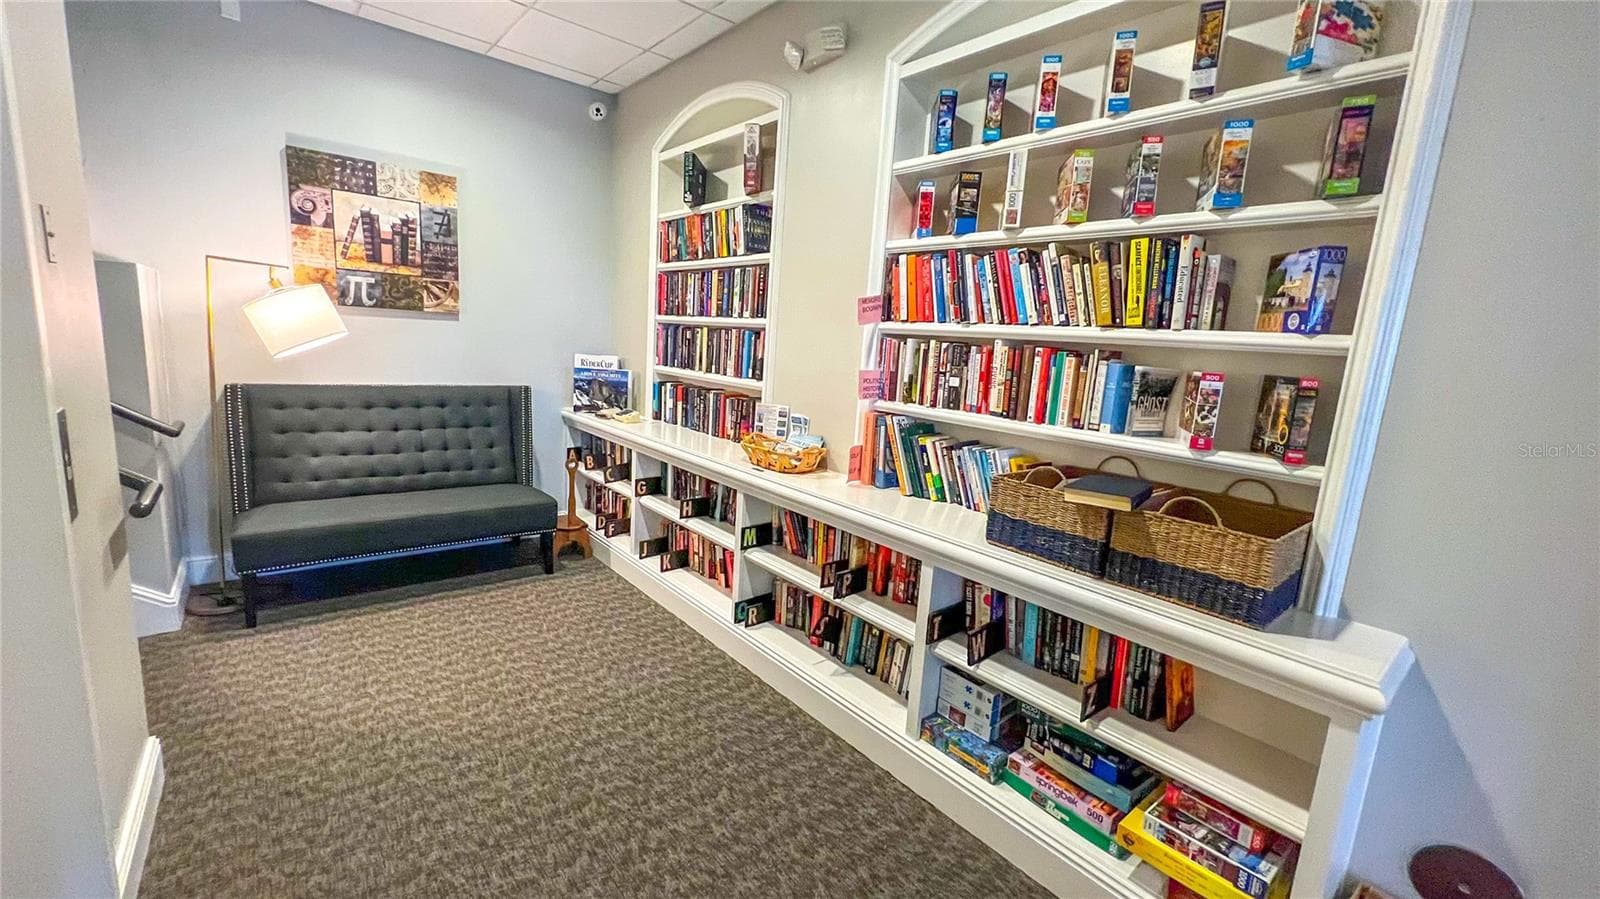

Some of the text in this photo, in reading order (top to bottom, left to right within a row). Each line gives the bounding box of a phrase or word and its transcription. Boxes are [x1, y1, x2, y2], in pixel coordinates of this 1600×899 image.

[1099, 264, 1109, 314] ELEANOR
[1177, 265, 1189, 303] Educated
[1137, 395, 1169, 411] GHOST
[586, 455, 594, 469] B
[606, 468, 615, 481] C
[637, 481, 647, 495] G
[682, 500, 693, 517] H
[598, 516, 606, 529] D
[608, 523, 615, 536] F
[743, 527, 757, 546] M
[640, 541, 648, 557] J
[662, 554, 672, 570] K
[823, 563, 836, 589] N
[748, 607, 758, 625] R
[971, 629, 987, 661] W
[1036, 776, 1078, 808] springbok
[1086, 808, 1104, 824] 500
